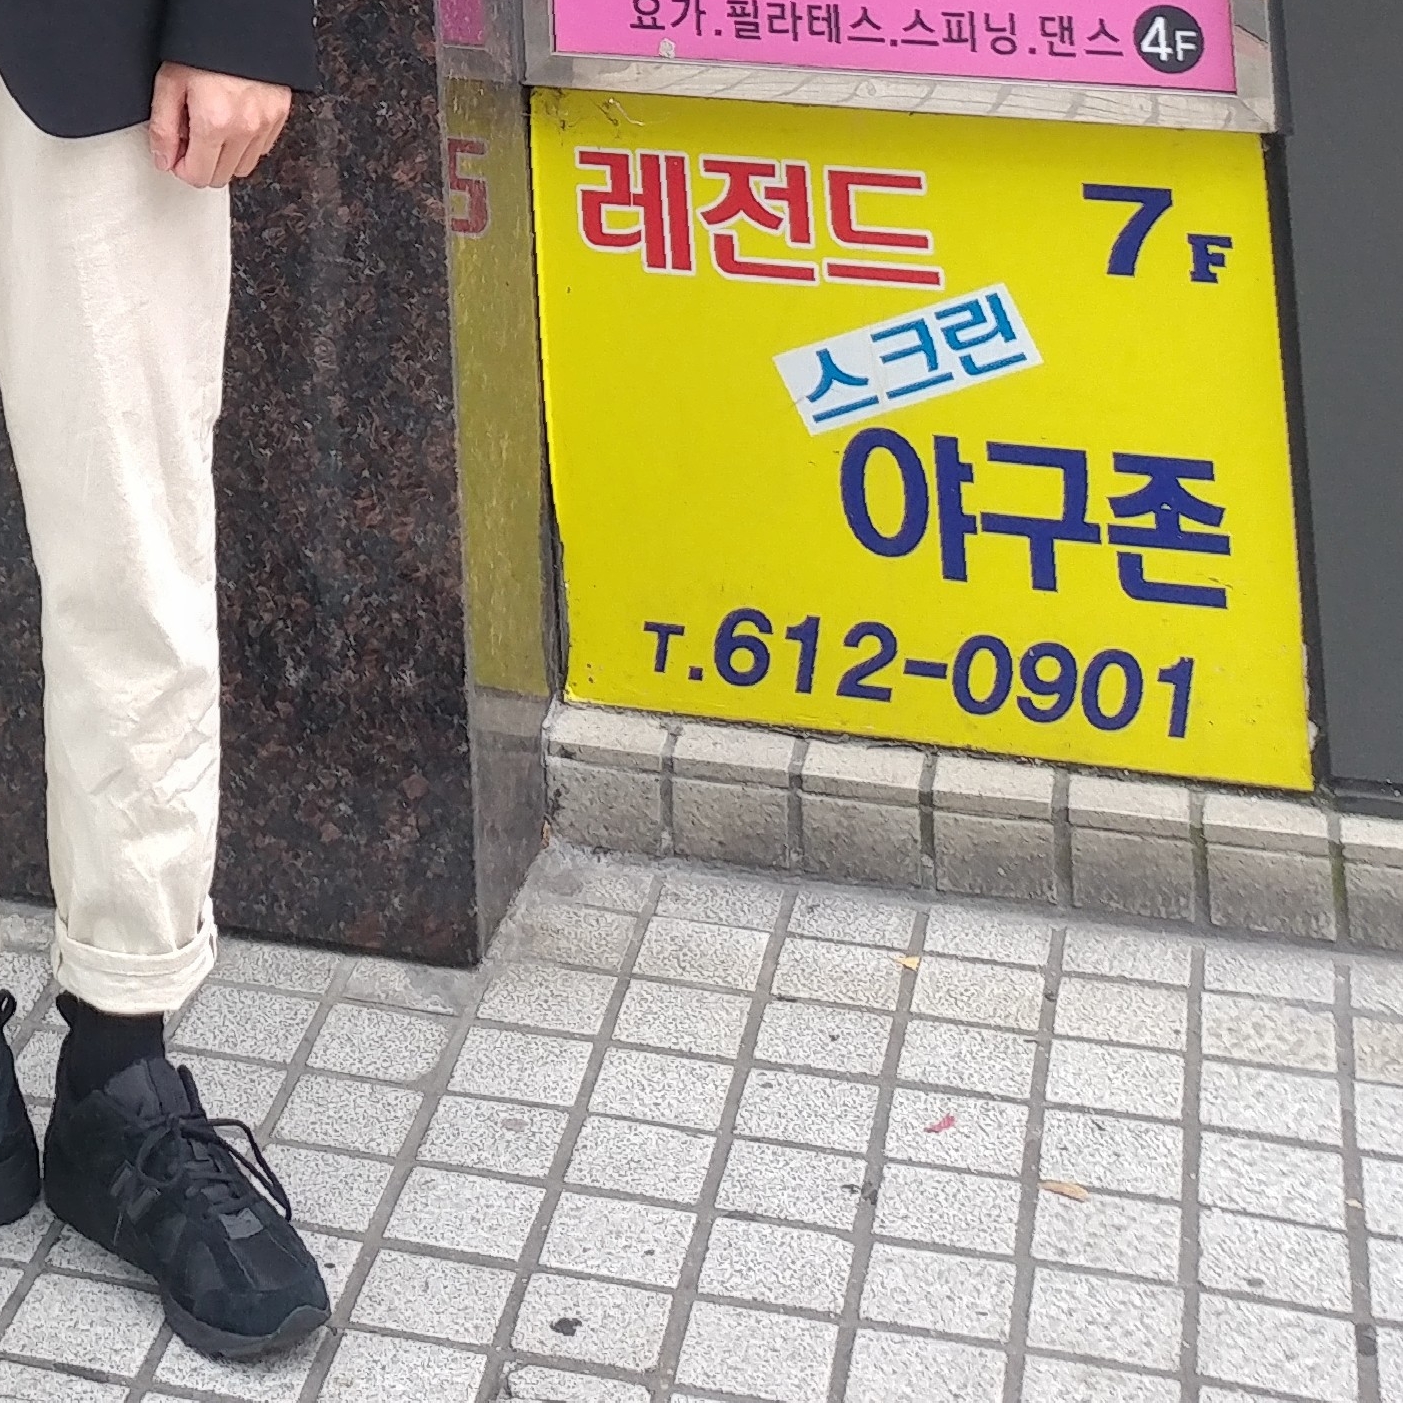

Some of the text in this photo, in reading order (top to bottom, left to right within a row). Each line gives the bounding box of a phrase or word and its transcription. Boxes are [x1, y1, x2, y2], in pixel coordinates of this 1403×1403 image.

[1140, 16, 1197, 62] 4F
[576, 147, 944, 288] 레전드
[808, 293, 1027, 423] 스크린
[839, 427, 1232, 610] 야구존
[643, 606, 1195, 740] T.612-0901
